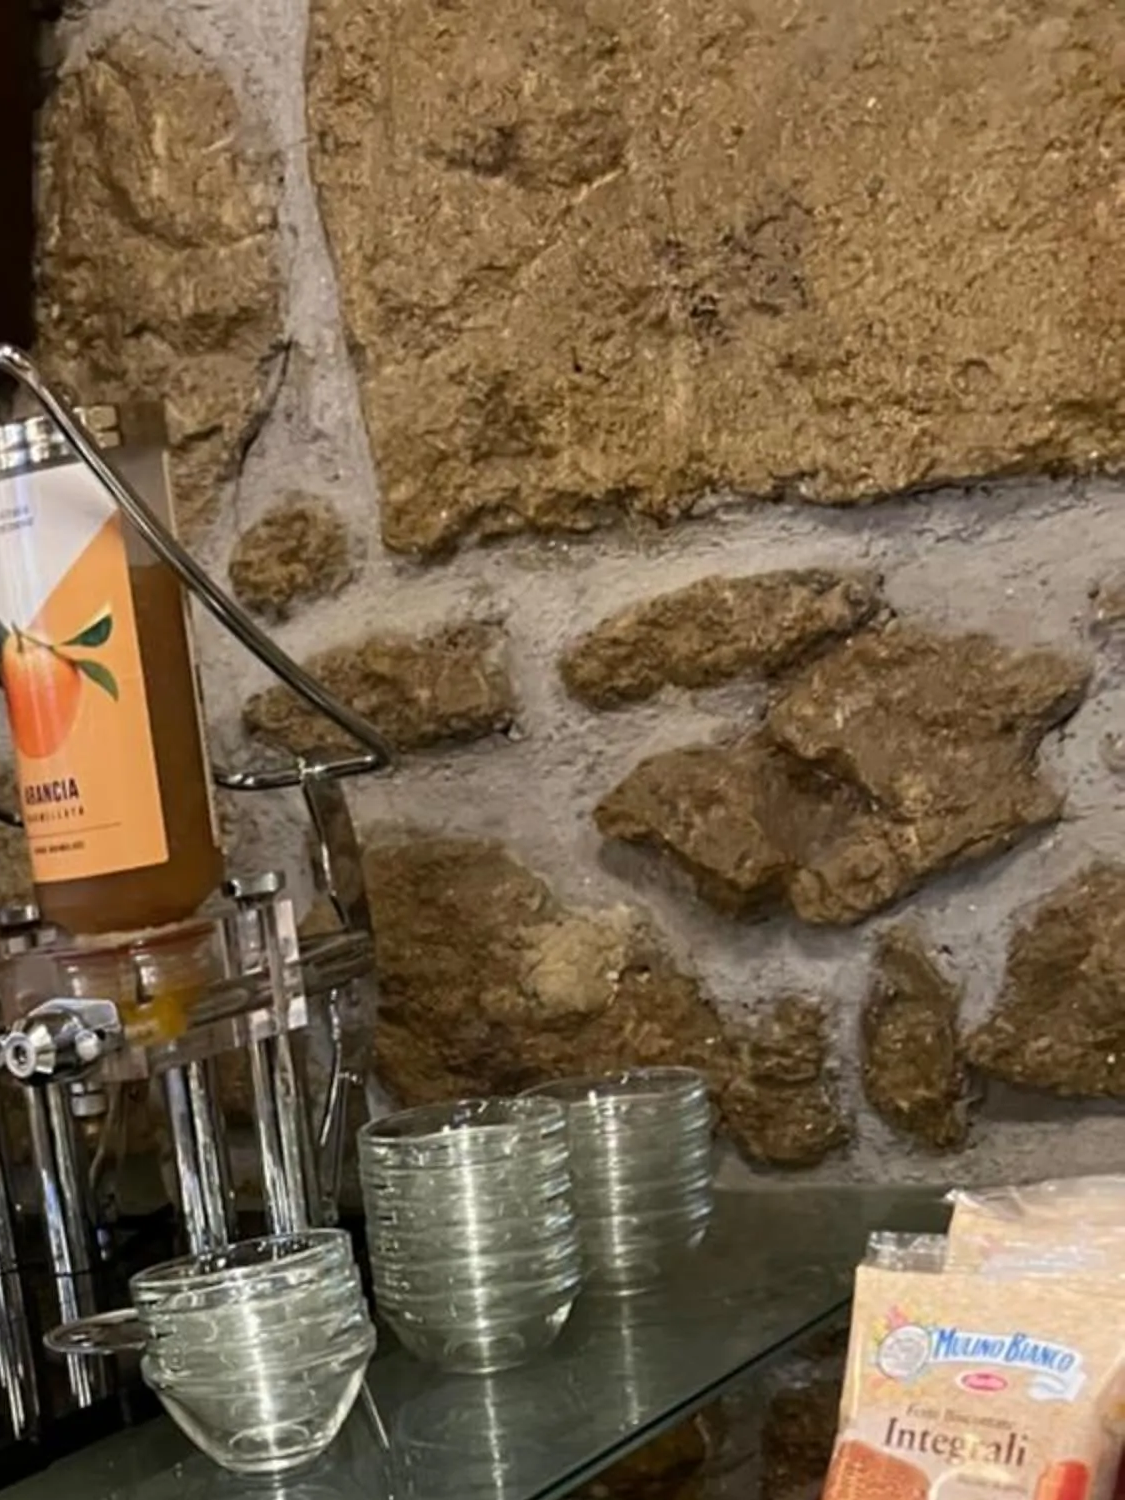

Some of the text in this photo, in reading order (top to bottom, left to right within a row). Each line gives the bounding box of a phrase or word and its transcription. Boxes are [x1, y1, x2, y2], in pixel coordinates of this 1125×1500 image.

[933, 1328, 1075, 1373] MULINO BIANCO
[884, 1416, 1029, 1467] Integrali
